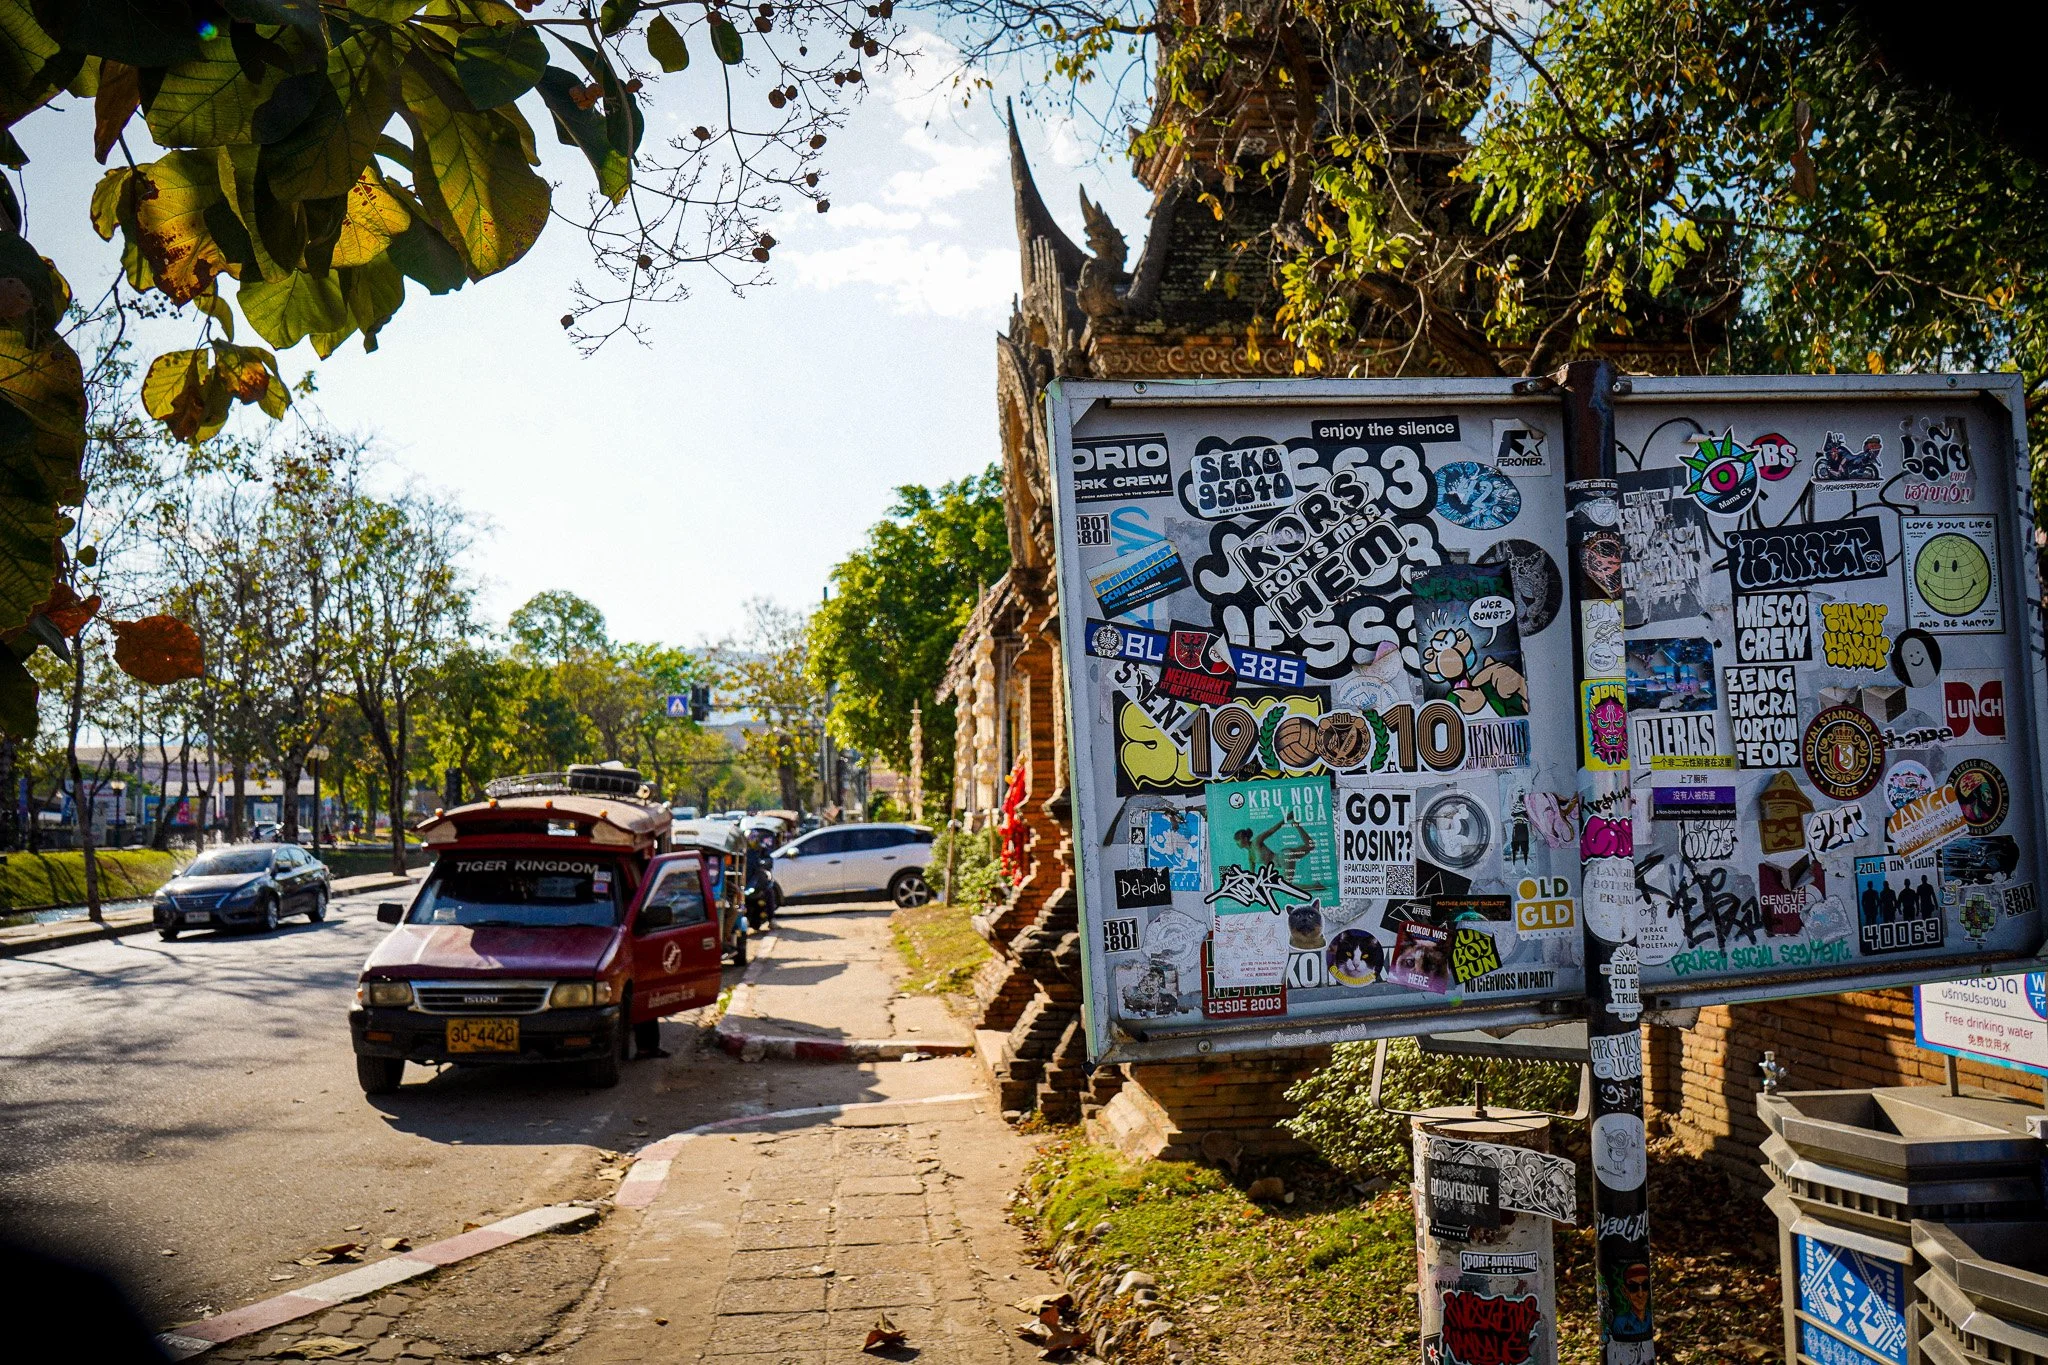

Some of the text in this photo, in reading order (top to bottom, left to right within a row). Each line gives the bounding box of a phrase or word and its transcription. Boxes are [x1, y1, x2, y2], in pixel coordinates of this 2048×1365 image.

[1320, 420, 1455, 440] enjoy the silence
[1113, 473, 1169, 488] CREW
[1718, 487, 1752, 510] Mama G's
[1906, 520, 1993, 530] LOVE YOUR LIFE
[1094, 544, 1173, 595] FREIBIERFEST
[1101, 555, 1180, 605] SCHALKSTETTEN
[1480, 600, 1503, 609] WER
[1736, 593, 1807, 629] MISCO
[1472, 610, 1512, 621] SONST?
[1919, 618, 1995, 628] AND BE HAPPY
[1739, 625, 1809, 661] CREW
[1125, 632, 1300, 685] BL 385
[1725, 667, 1796, 692] ZENG
[1728, 691, 1797, 718] EMCRA
[1946, 698, 2003, 720] LUNCH
[1382, 702, 1467, 774] 10
[1806, 709, 1882, 765] ROYAL STANDARD CLUB
[1465, 755, 1475, 770] ART
[1498, 752, 1529, 768] COLLECTIVE
[1247, 786, 1325, 808] KRU NOY
[1672, 790, 1716, 801] 没有人被伤害
[1829, 785, 1860, 796] LIEGE
[1280, 803, 1327, 824] YOGA
[1345, 793, 1411, 826] GOT
[1900, 829, 1910, 838] an
[1909, 822, 1923, 834] der
[1922, 814, 1942, 828] Leine
[1344, 830, 1413, 863] ROSIN??
[456, 858, 600, 874] TIGER KINGDOM
[1343, 864, 1385, 874] @PAKTASUPPLY
[1858, 861, 1887, 875] ZOLA
[1890, 859, 1905, 872] ON
[1343, 875, 1385, 885] @PAKTASUPPLY
[1343, 886, 1385, 896] @PAKTASUPPLY
[1760, 894, 1806, 906] GENEVE
[1520, 904, 1571, 927] GLD
[1432, 928, 1448, 941] WAS
[1639, 926, 1669, 934] VERACE
[1863, 917, 1941, 950] 40069
[1452, 936, 1493, 968] BOY
[1455, 953, 1499, 983] RUN
[1614, 963, 1639, 975] GOOD
[1517, 971, 1528, 989] NO
[1529, 970, 1555, 988] PARTY
[1612, 977, 1639, 990] TO BE
[1208, 997, 1282, 1014] DESDE 2003
[1614, 992, 1639, 1004] TRUE
[450, 1025, 515, 1043] 30-4420
[1944, 1011, 2034, 1041] Free drinking water
